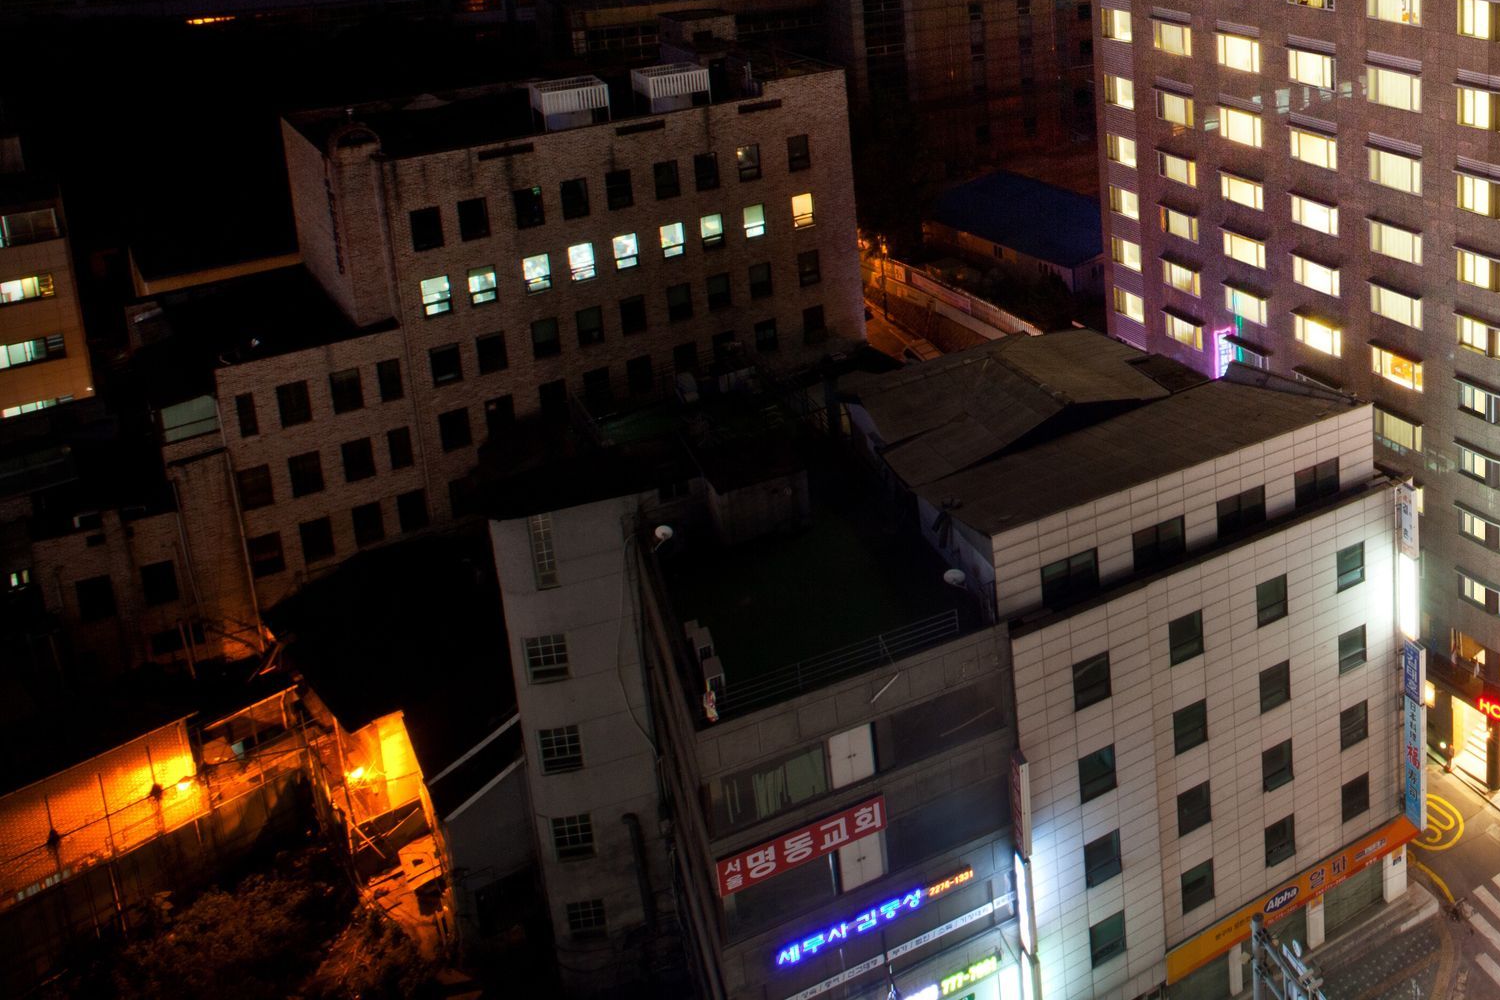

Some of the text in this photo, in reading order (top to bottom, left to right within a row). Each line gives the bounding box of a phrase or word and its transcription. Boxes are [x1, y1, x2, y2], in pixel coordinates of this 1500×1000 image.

[746, 801, 882, 878] 명동교회
[1266, 887, 1298, 912] Alpha
[778, 923, 848, 965] 세무사
